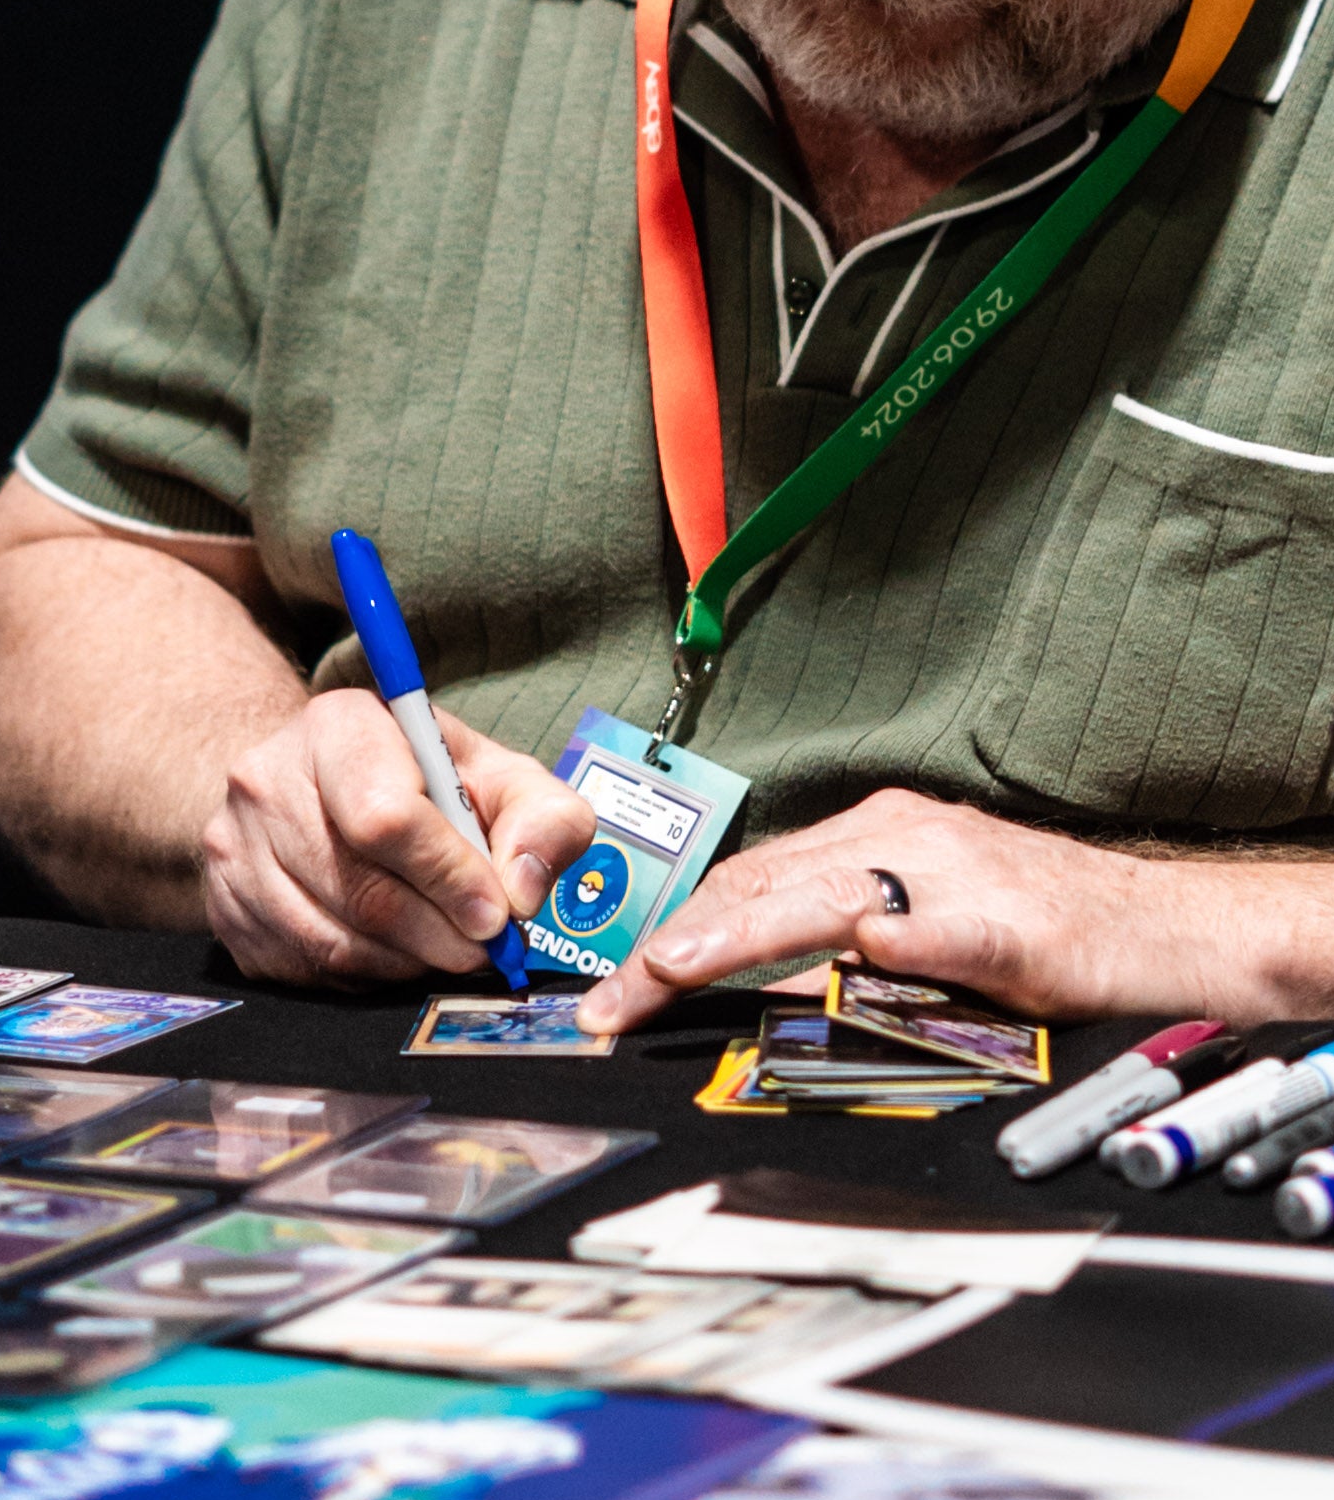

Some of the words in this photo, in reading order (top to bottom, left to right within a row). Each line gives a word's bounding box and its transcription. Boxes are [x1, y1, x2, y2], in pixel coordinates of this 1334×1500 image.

[641, 60, 662, 154] ebay
[859, 286, 1015, 440] 29.06.2024
[666, 822, 683, 840] 10
